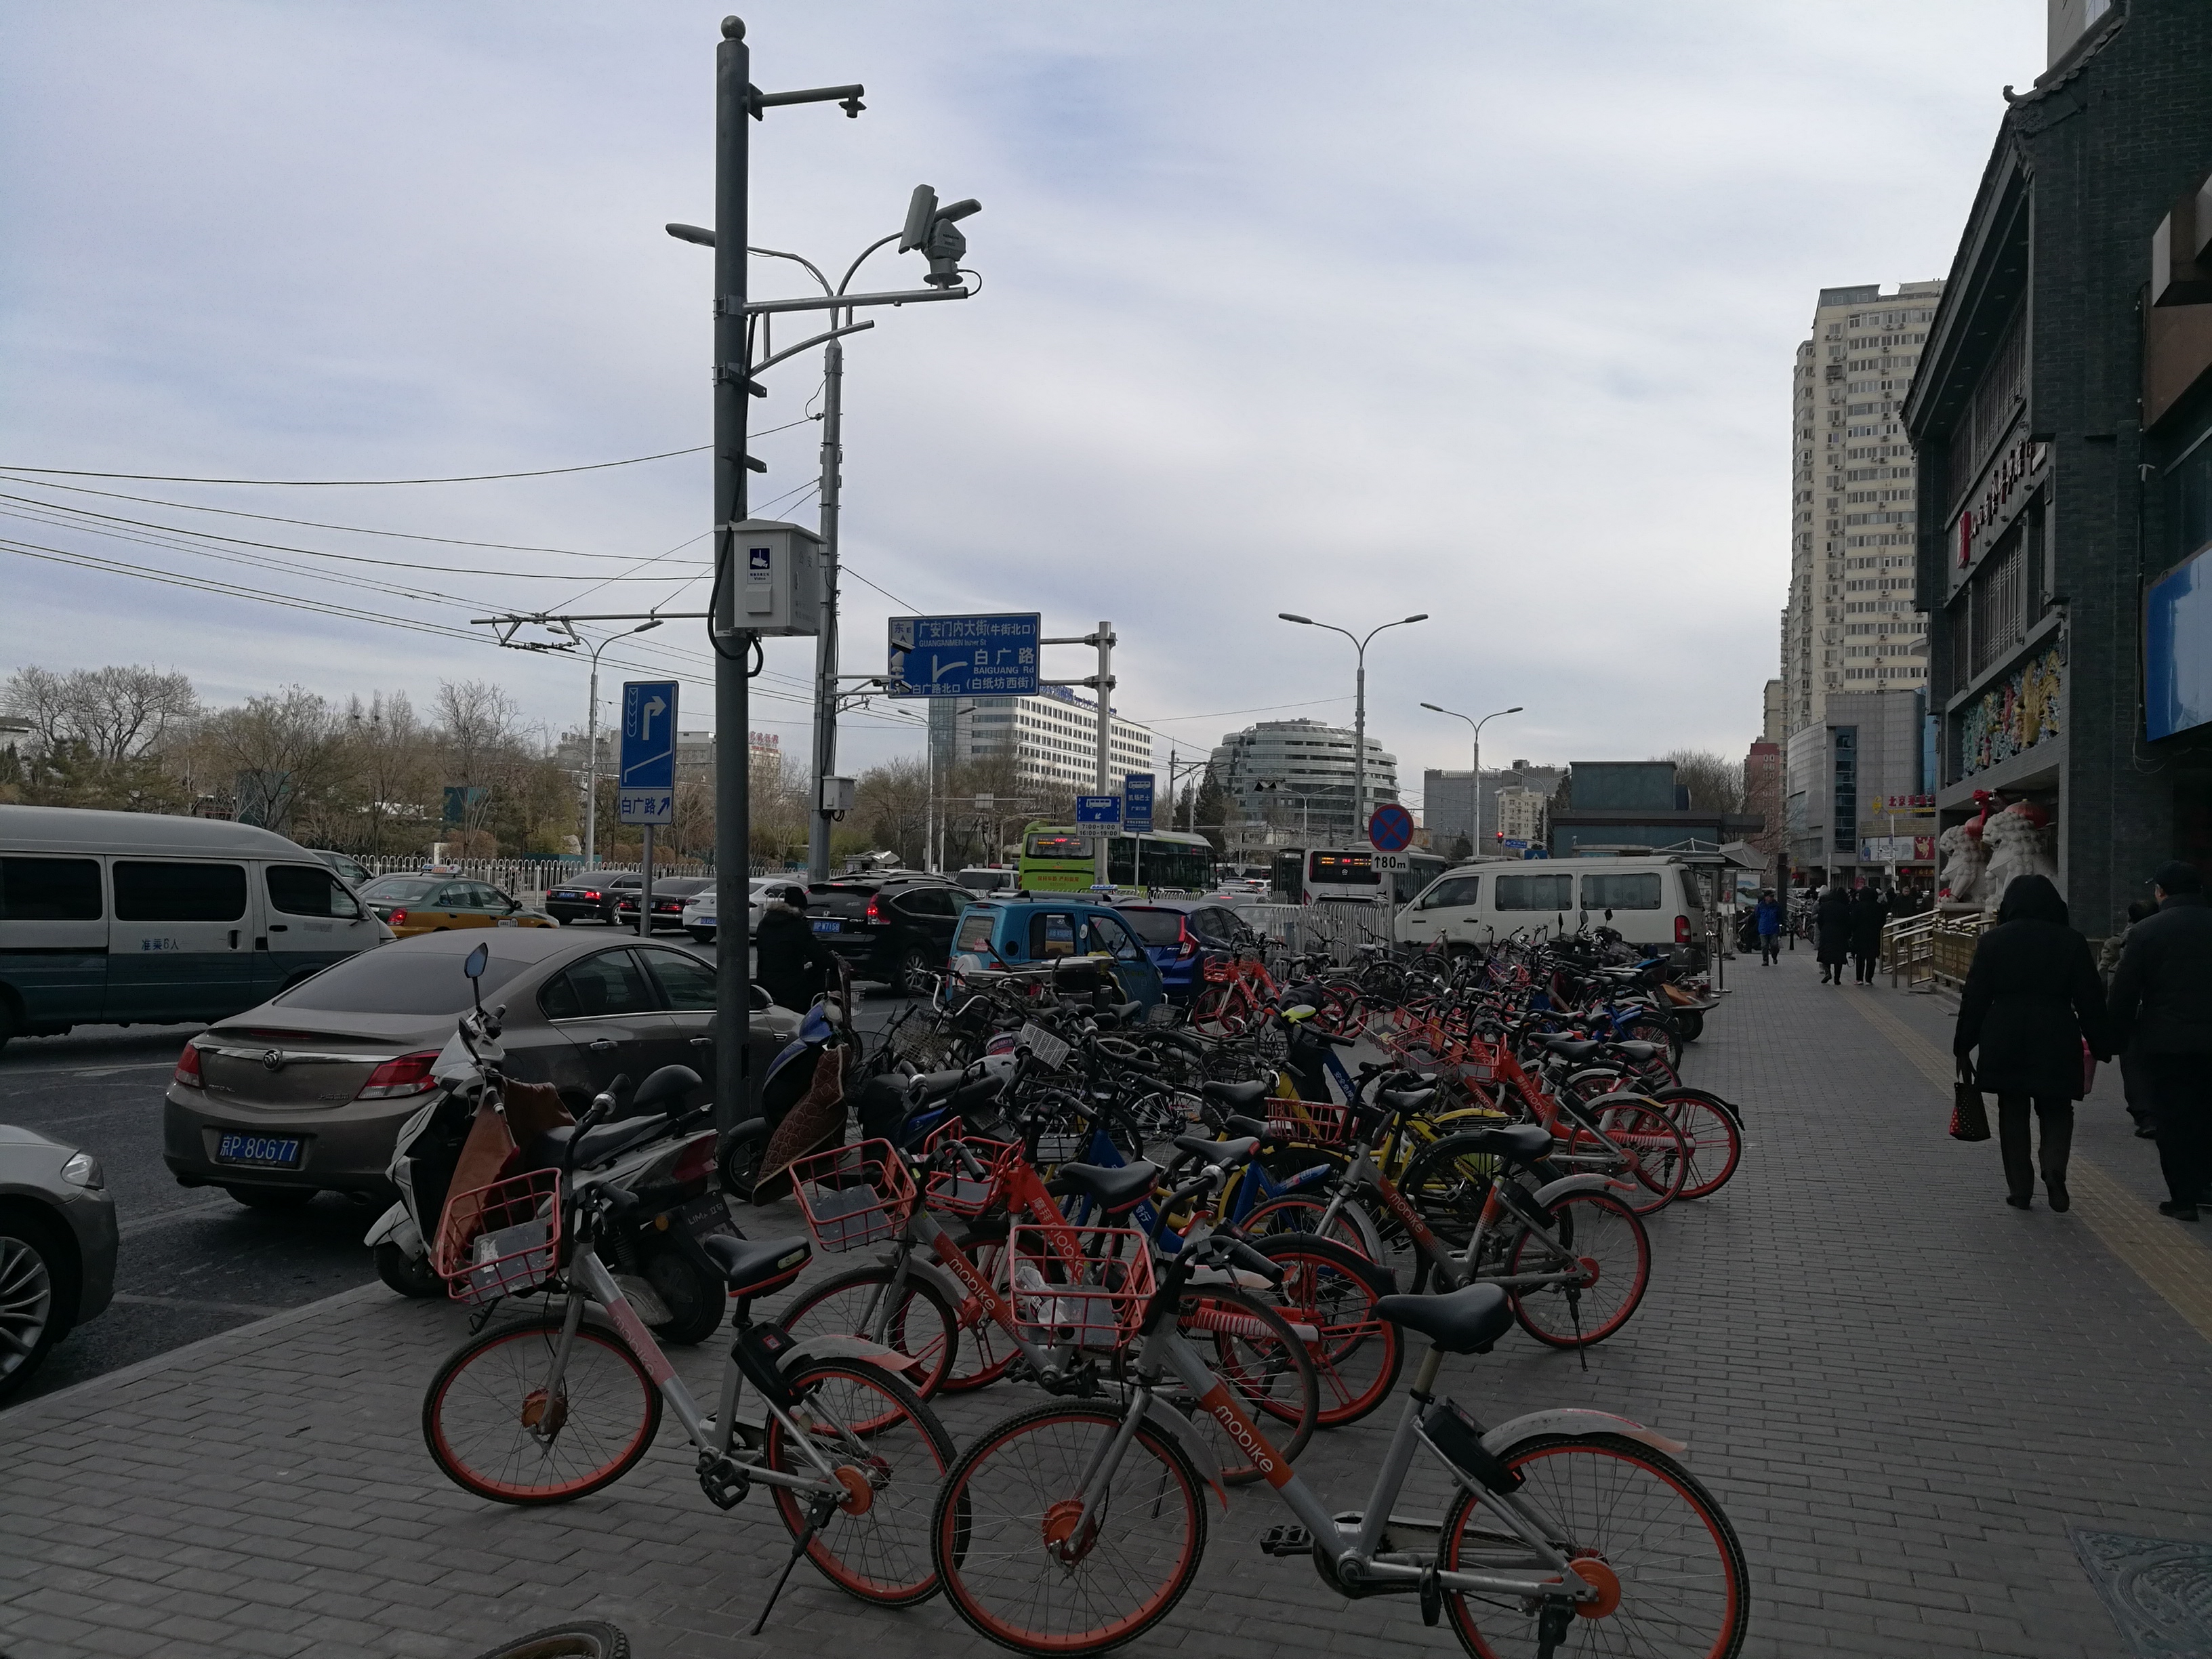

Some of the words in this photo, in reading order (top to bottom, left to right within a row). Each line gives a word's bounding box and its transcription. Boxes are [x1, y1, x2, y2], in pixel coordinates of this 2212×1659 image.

[894, 622, 904, 634] 东
[975, 647, 1035, 665] 白广路
[973, 666, 1019, 674] BAIGUANG
[912, 683, 960, 695] 白广路北口
[621, 797, 656, 815] 白广路
[142, 939, 179, 950] 准乘6人
[1525, 1089, 1548, 1118] mobik
[1031, 1197, 1054, 1222] 摩拜
[1389, 1193, 1423, 1233] mobike
[949, 1258, 995, 1310] mobike
[613, 1315, 654, 1376] mobike
[1214, 1406, 1273, 1473] mobike
